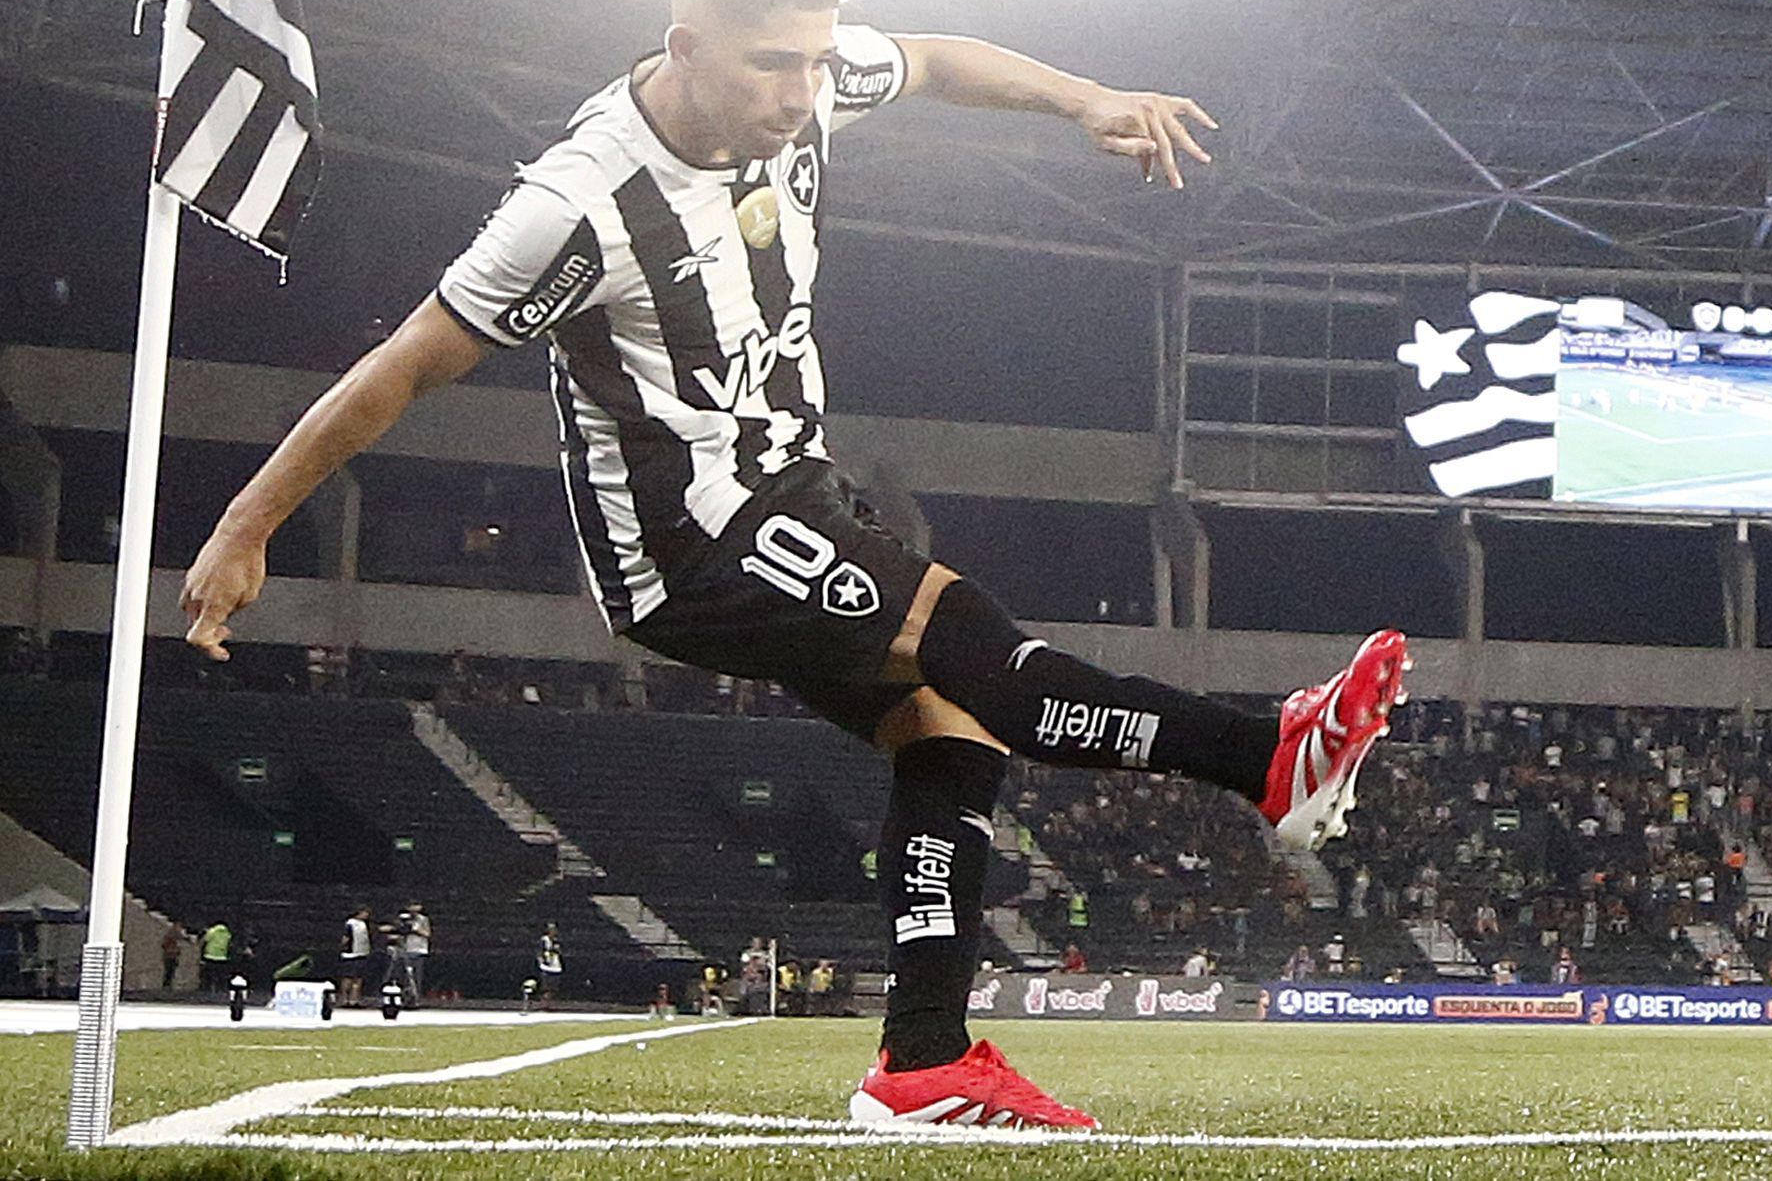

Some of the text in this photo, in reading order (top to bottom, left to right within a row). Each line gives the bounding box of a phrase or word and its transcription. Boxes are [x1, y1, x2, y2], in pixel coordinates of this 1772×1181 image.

[692, 306, 812, 410] vbe
[740, 514, 836, 601] 10
[1304, 992, 1429, 1019] BETesporte
[1640, 995, 1762, 1023] BETesporte
